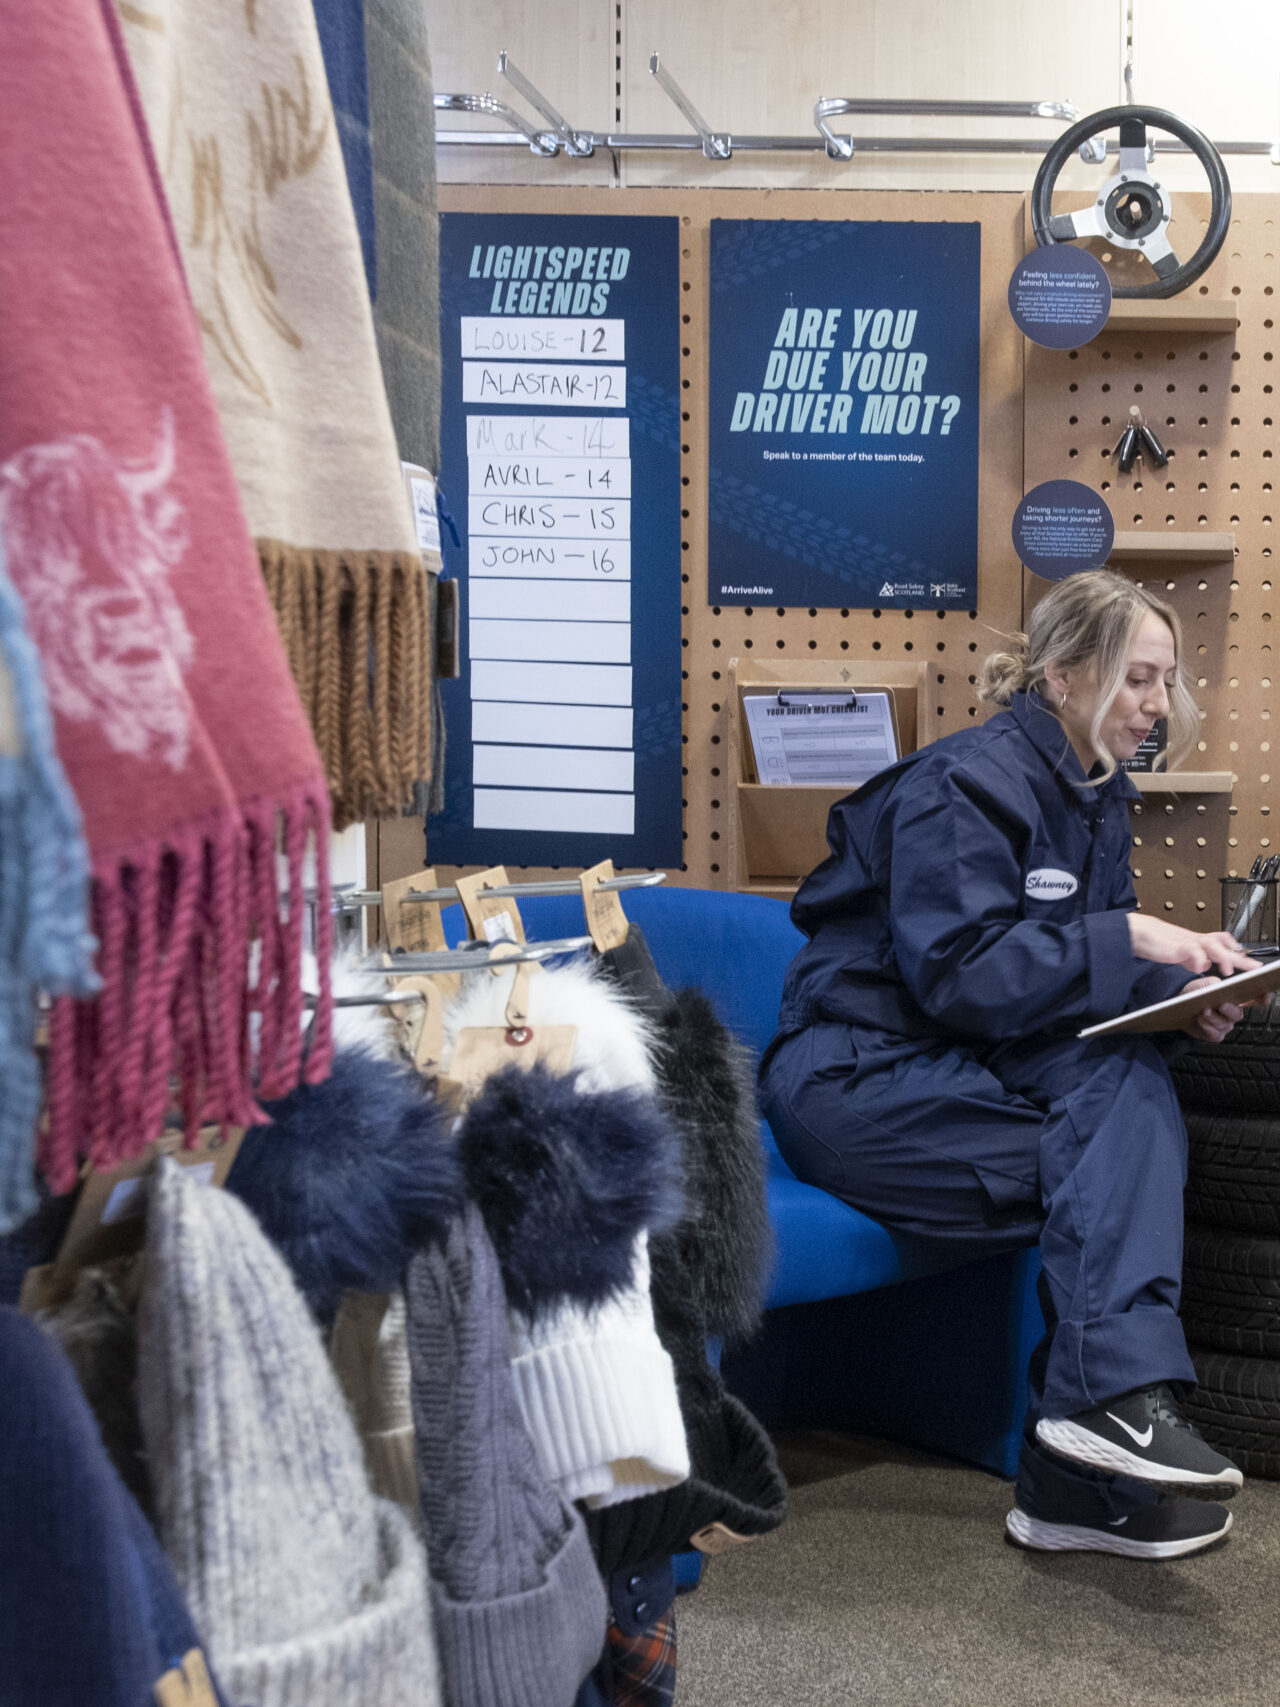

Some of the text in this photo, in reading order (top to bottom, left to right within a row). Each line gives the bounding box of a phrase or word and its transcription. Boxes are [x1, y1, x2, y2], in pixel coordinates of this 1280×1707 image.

[469, 245, 631, 281] LIGHTSPEED
[1023, 270, 1048, 279] Feeling
[1019, 279, 1042, 287] behind
[1077, 281, 1100, 289] lately?
[490, 281, 610, 316] LEGENDS
[773, 307, 918, 350] ARE YOU
[763, 351, 928, 393] DUE YOUR
[729, 392, 960, 436] DRIVER MOT?
[763, 451, 790, 462] Speak
[792, 451, 800, 460] to
[810, 451, 846, 461] member
[848, 451, 857, 461] of
[858, 452, 873, 462] the
[874, 453, 897, 462] team
[899, 452, 925, 464] today.
[481, 502, 556, 529] CHRIS
[1027, 506, 1051, 514] Driving
[1022, 515, 1043, 523] taking
[1070, 515, 1102, 524] journeys?
[481, 546, 555, 568] JOHN
[721, 585, 773, 596] #ArriveAlive
[766, 708, 785, 716] YOUR
[1026, 876, 1074, 893] Shawney
